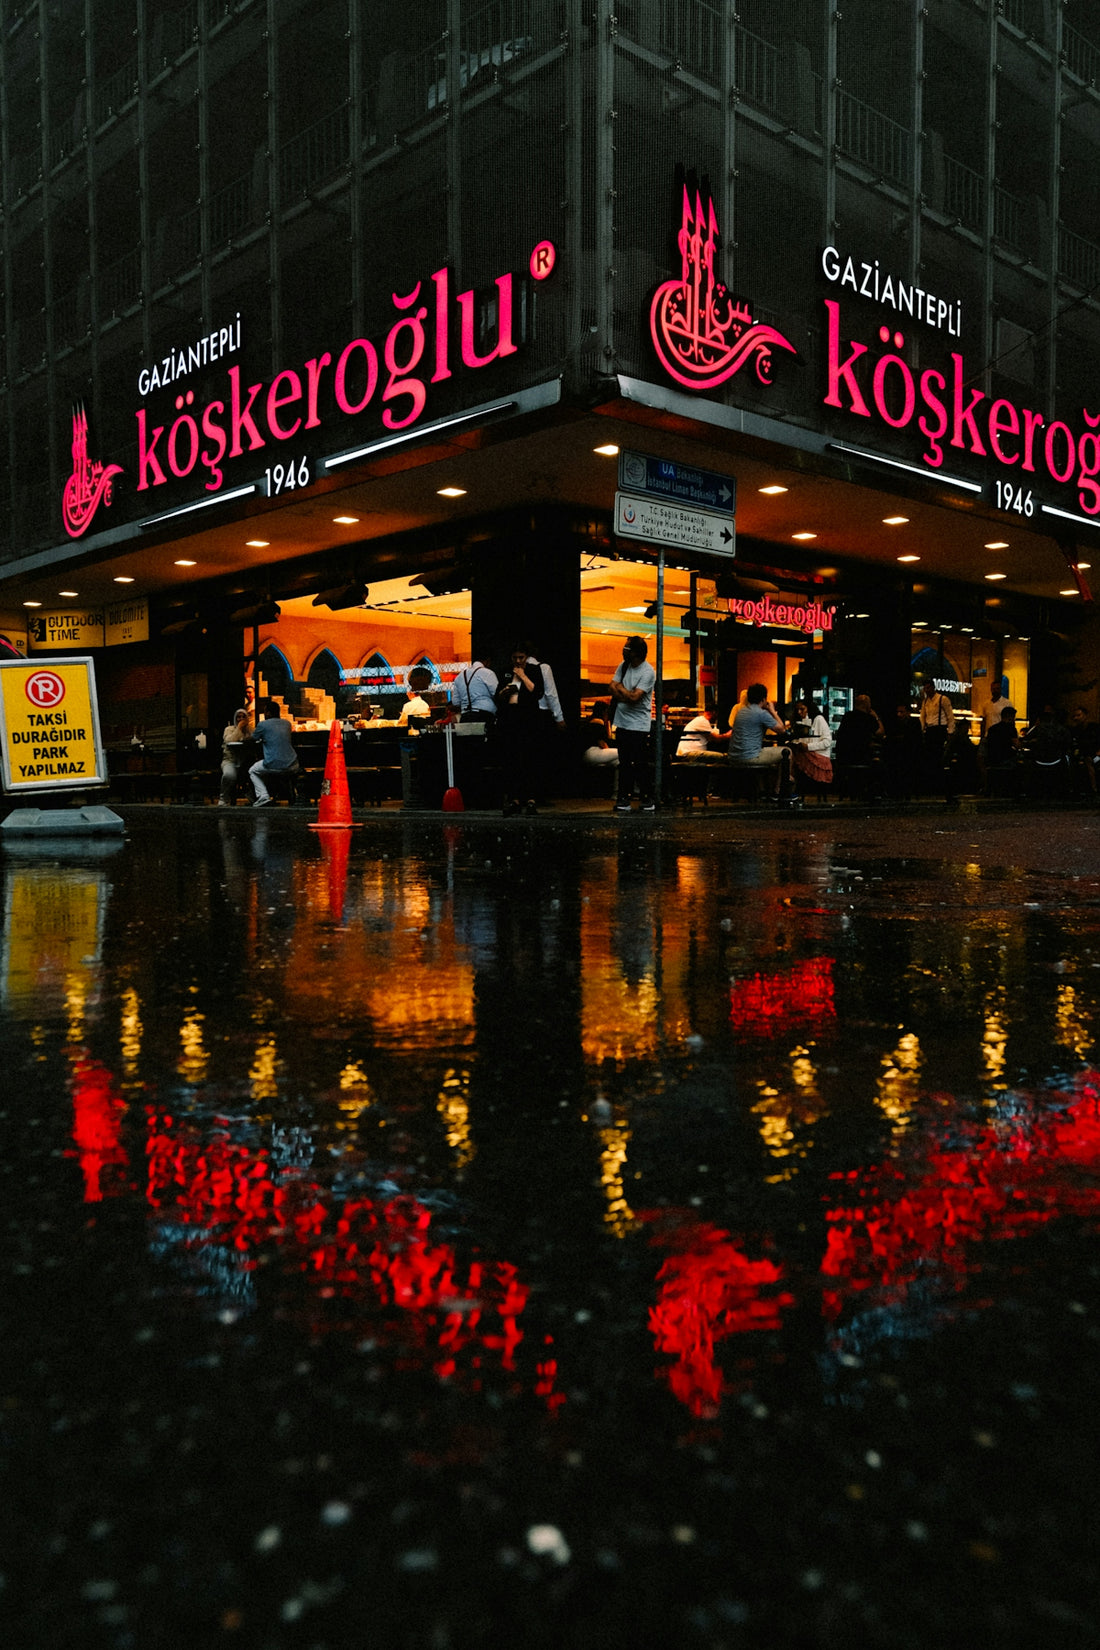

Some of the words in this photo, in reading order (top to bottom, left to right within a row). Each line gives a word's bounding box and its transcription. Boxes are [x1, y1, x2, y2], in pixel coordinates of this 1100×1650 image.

[823, 246, 961, 337] GAZİANTEPLİ
[138, 312, 241, 397] GAZİANTEPLİ
[135, 267, 518, 492] köşkeroğlu
[264, 455, 310, 498] 1946
[661, 462, 675, 476] UA
[995, 480, 1034, 517] 1946
[48, 614, 104, 627] OUTDOOR
[48, 628, 81, 641] TIME
[27, 709, 67, 727] TAKSİ
[12, 727, 86, 744] DURAĞIDIR
[33, 746, 69, 760] PARK
[19, 761, 86, 777] YAPILMAZ
